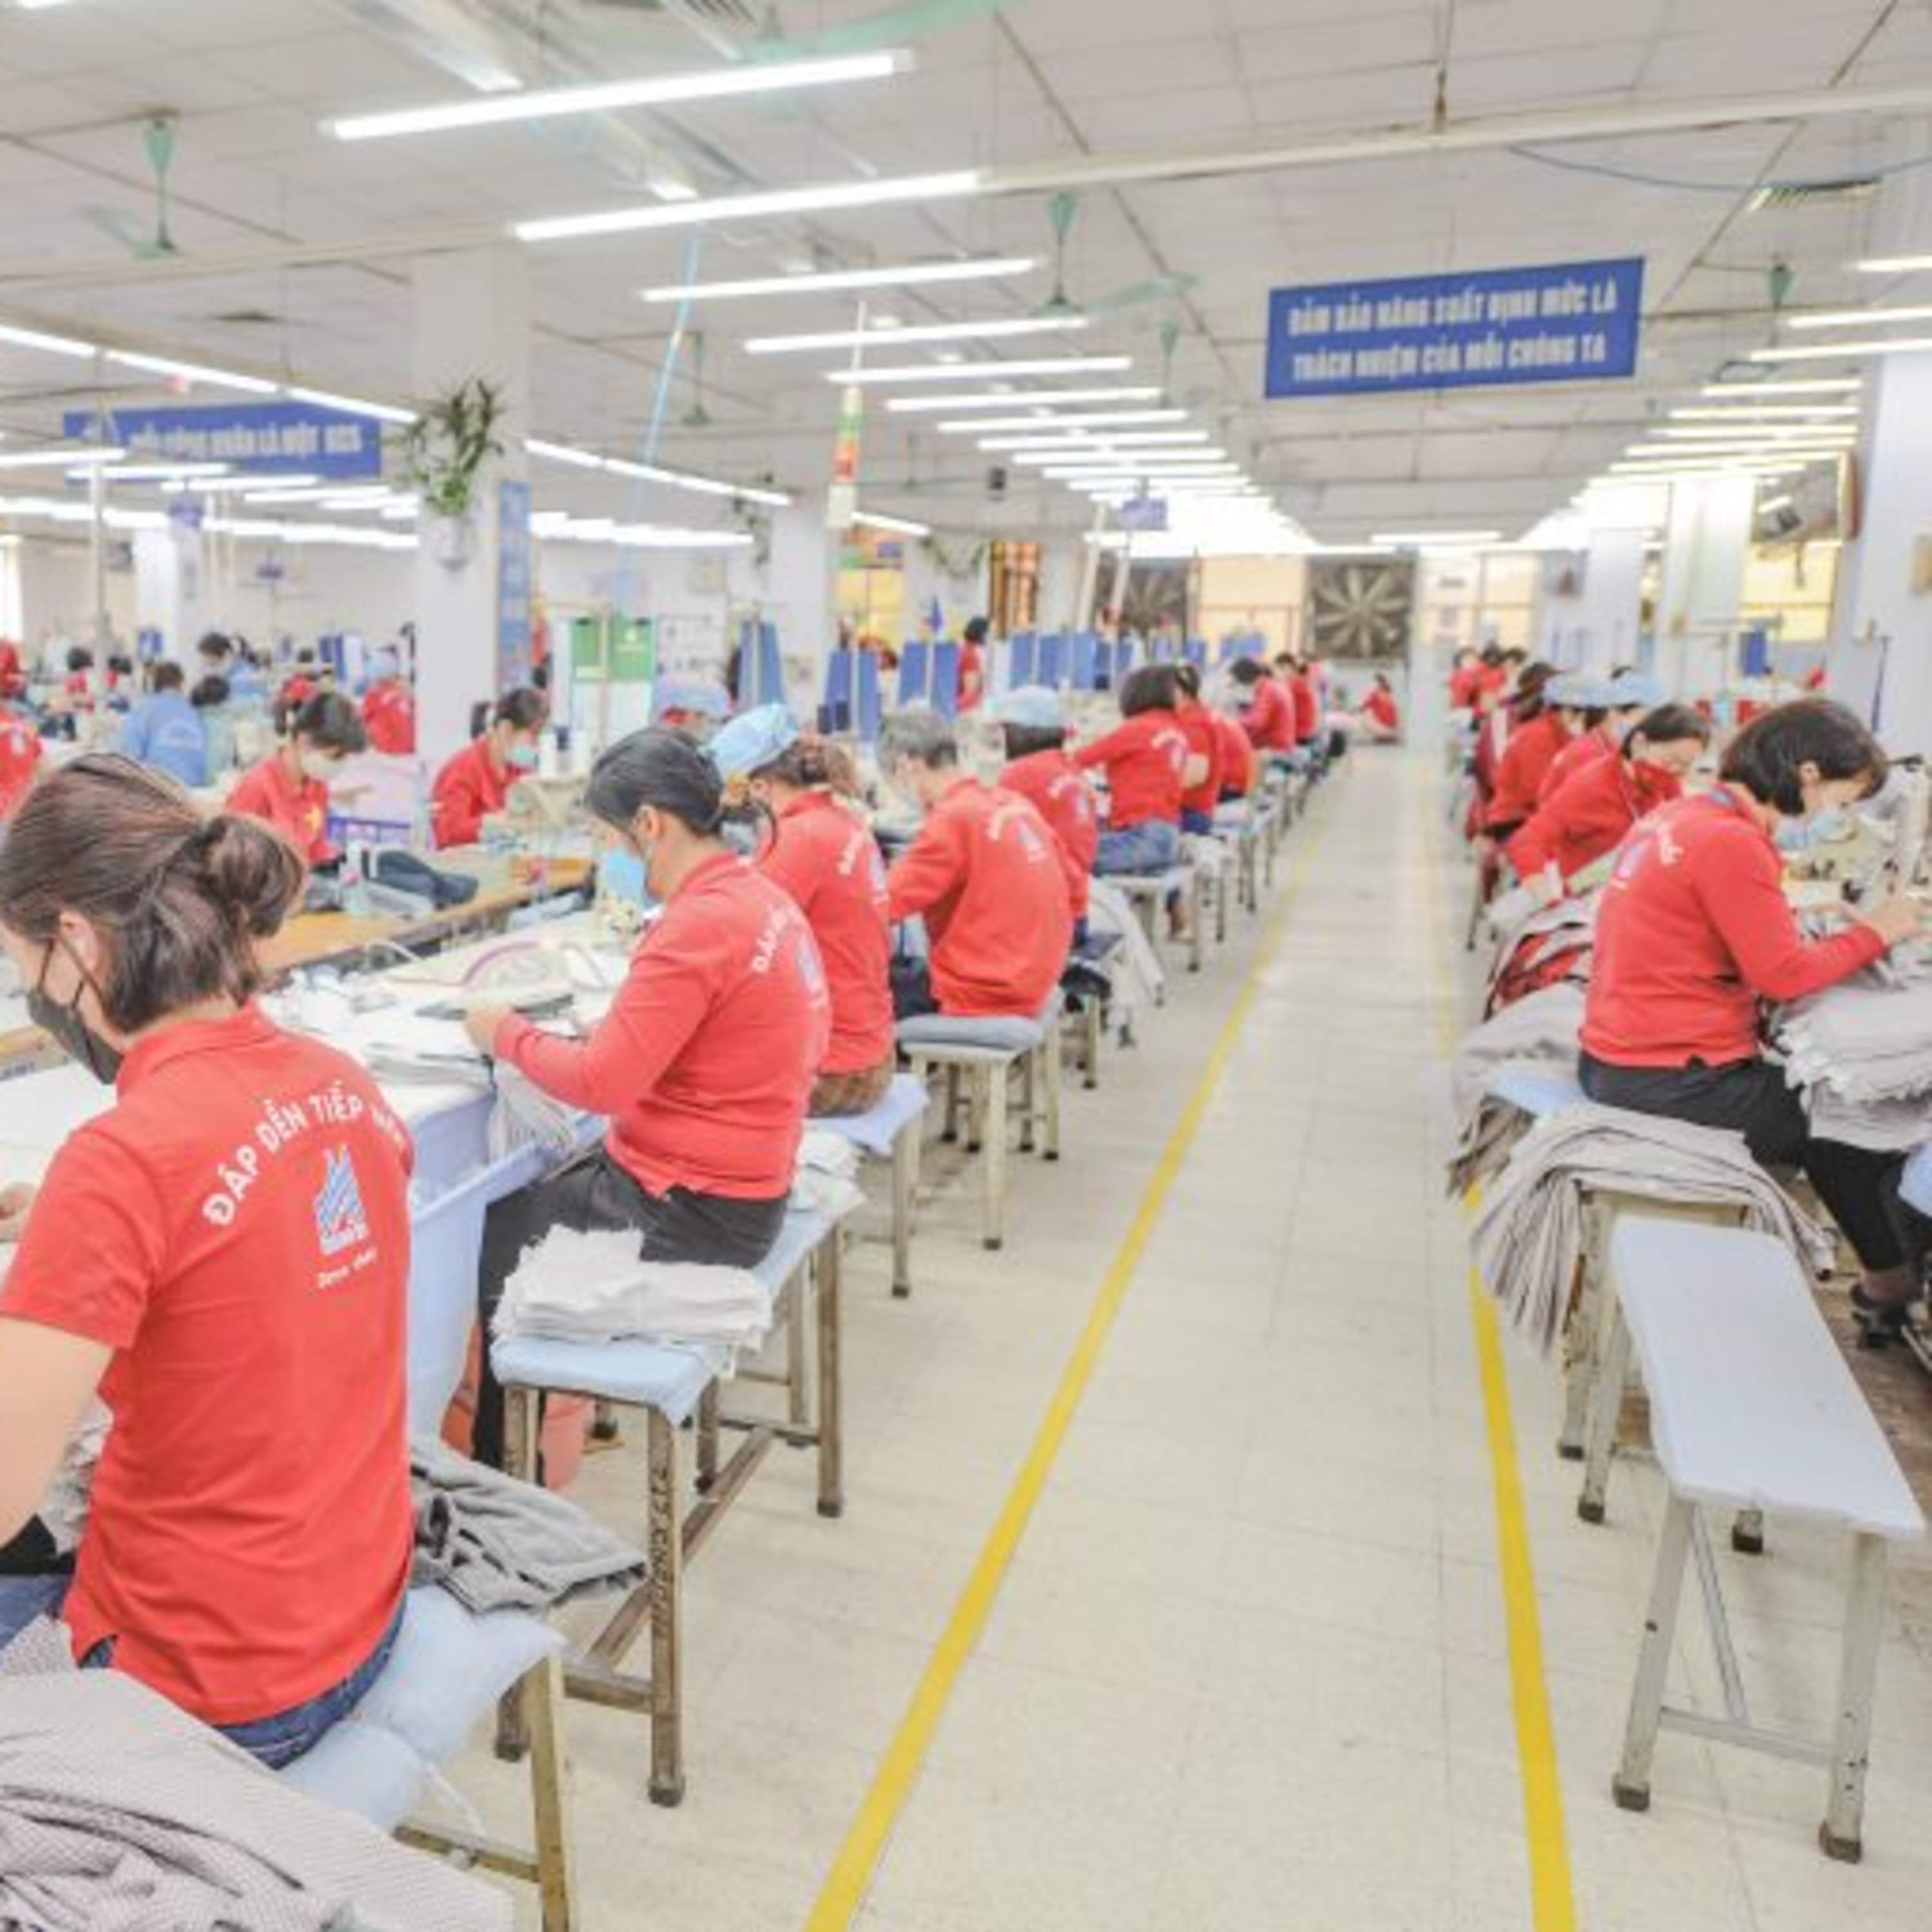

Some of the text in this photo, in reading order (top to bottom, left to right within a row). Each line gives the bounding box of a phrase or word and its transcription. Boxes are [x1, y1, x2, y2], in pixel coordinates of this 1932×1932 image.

[1592, 275, 1617, 314] LÀ
[1293, 345, 1352, 382] TRÁCH
[1423, 334, 1460, 374] CỦA
[1508, 332, 1575, 367] CHÚNG
[1581, 333, 1605, 362] TA
[202, 1144, 260, 1227] ĐÁP
[308, 1080, 364, 1122] TIẾP
